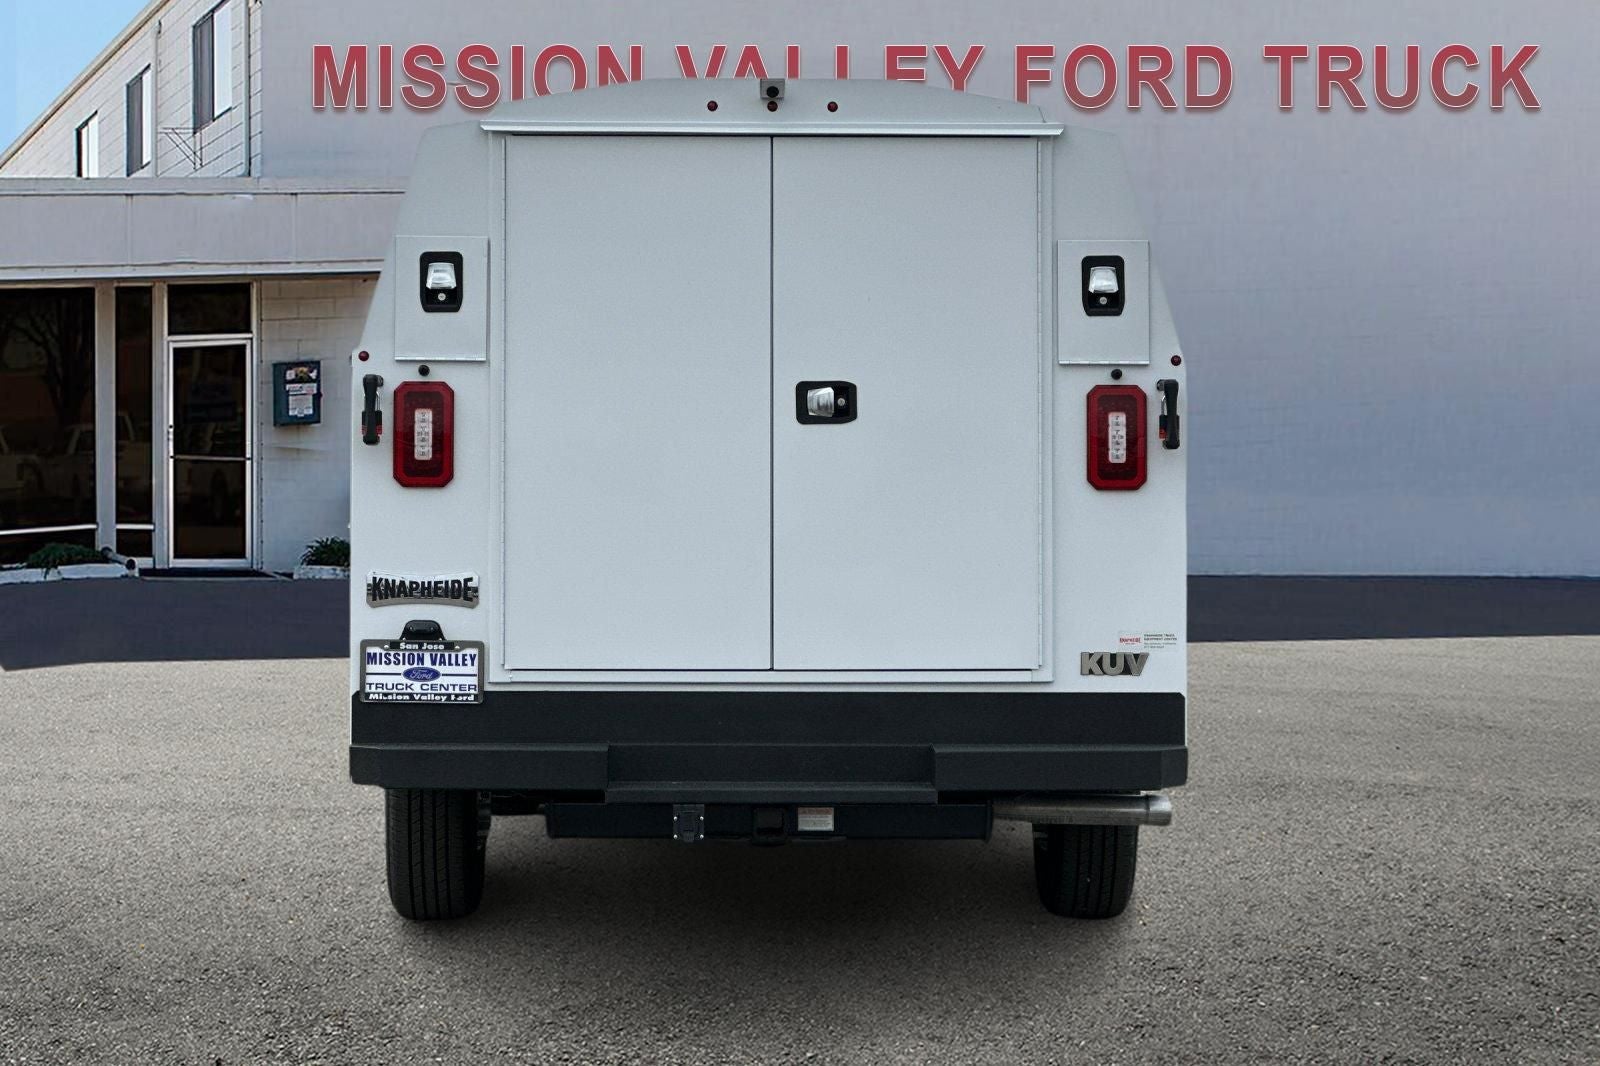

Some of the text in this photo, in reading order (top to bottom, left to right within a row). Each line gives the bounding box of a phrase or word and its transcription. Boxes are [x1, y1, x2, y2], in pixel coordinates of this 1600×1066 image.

[312, 44, 643, 109] MISSION
[1015, 44, 1233, 108] FORD
[1263, 44, 1542, 109] TRUCK
[371, 576, 474, 602] KNAPHEIDE
[400, 642, 419, 650] San
[366, 652, 477, 667] MISSION VALLEY
[1081, 652, 1150, 676] KUV
[409, 669, 433, 680] Ford
[366, 683, 478, 692] TRUCK CENTER
[413, 693, 447, 702] Valley
